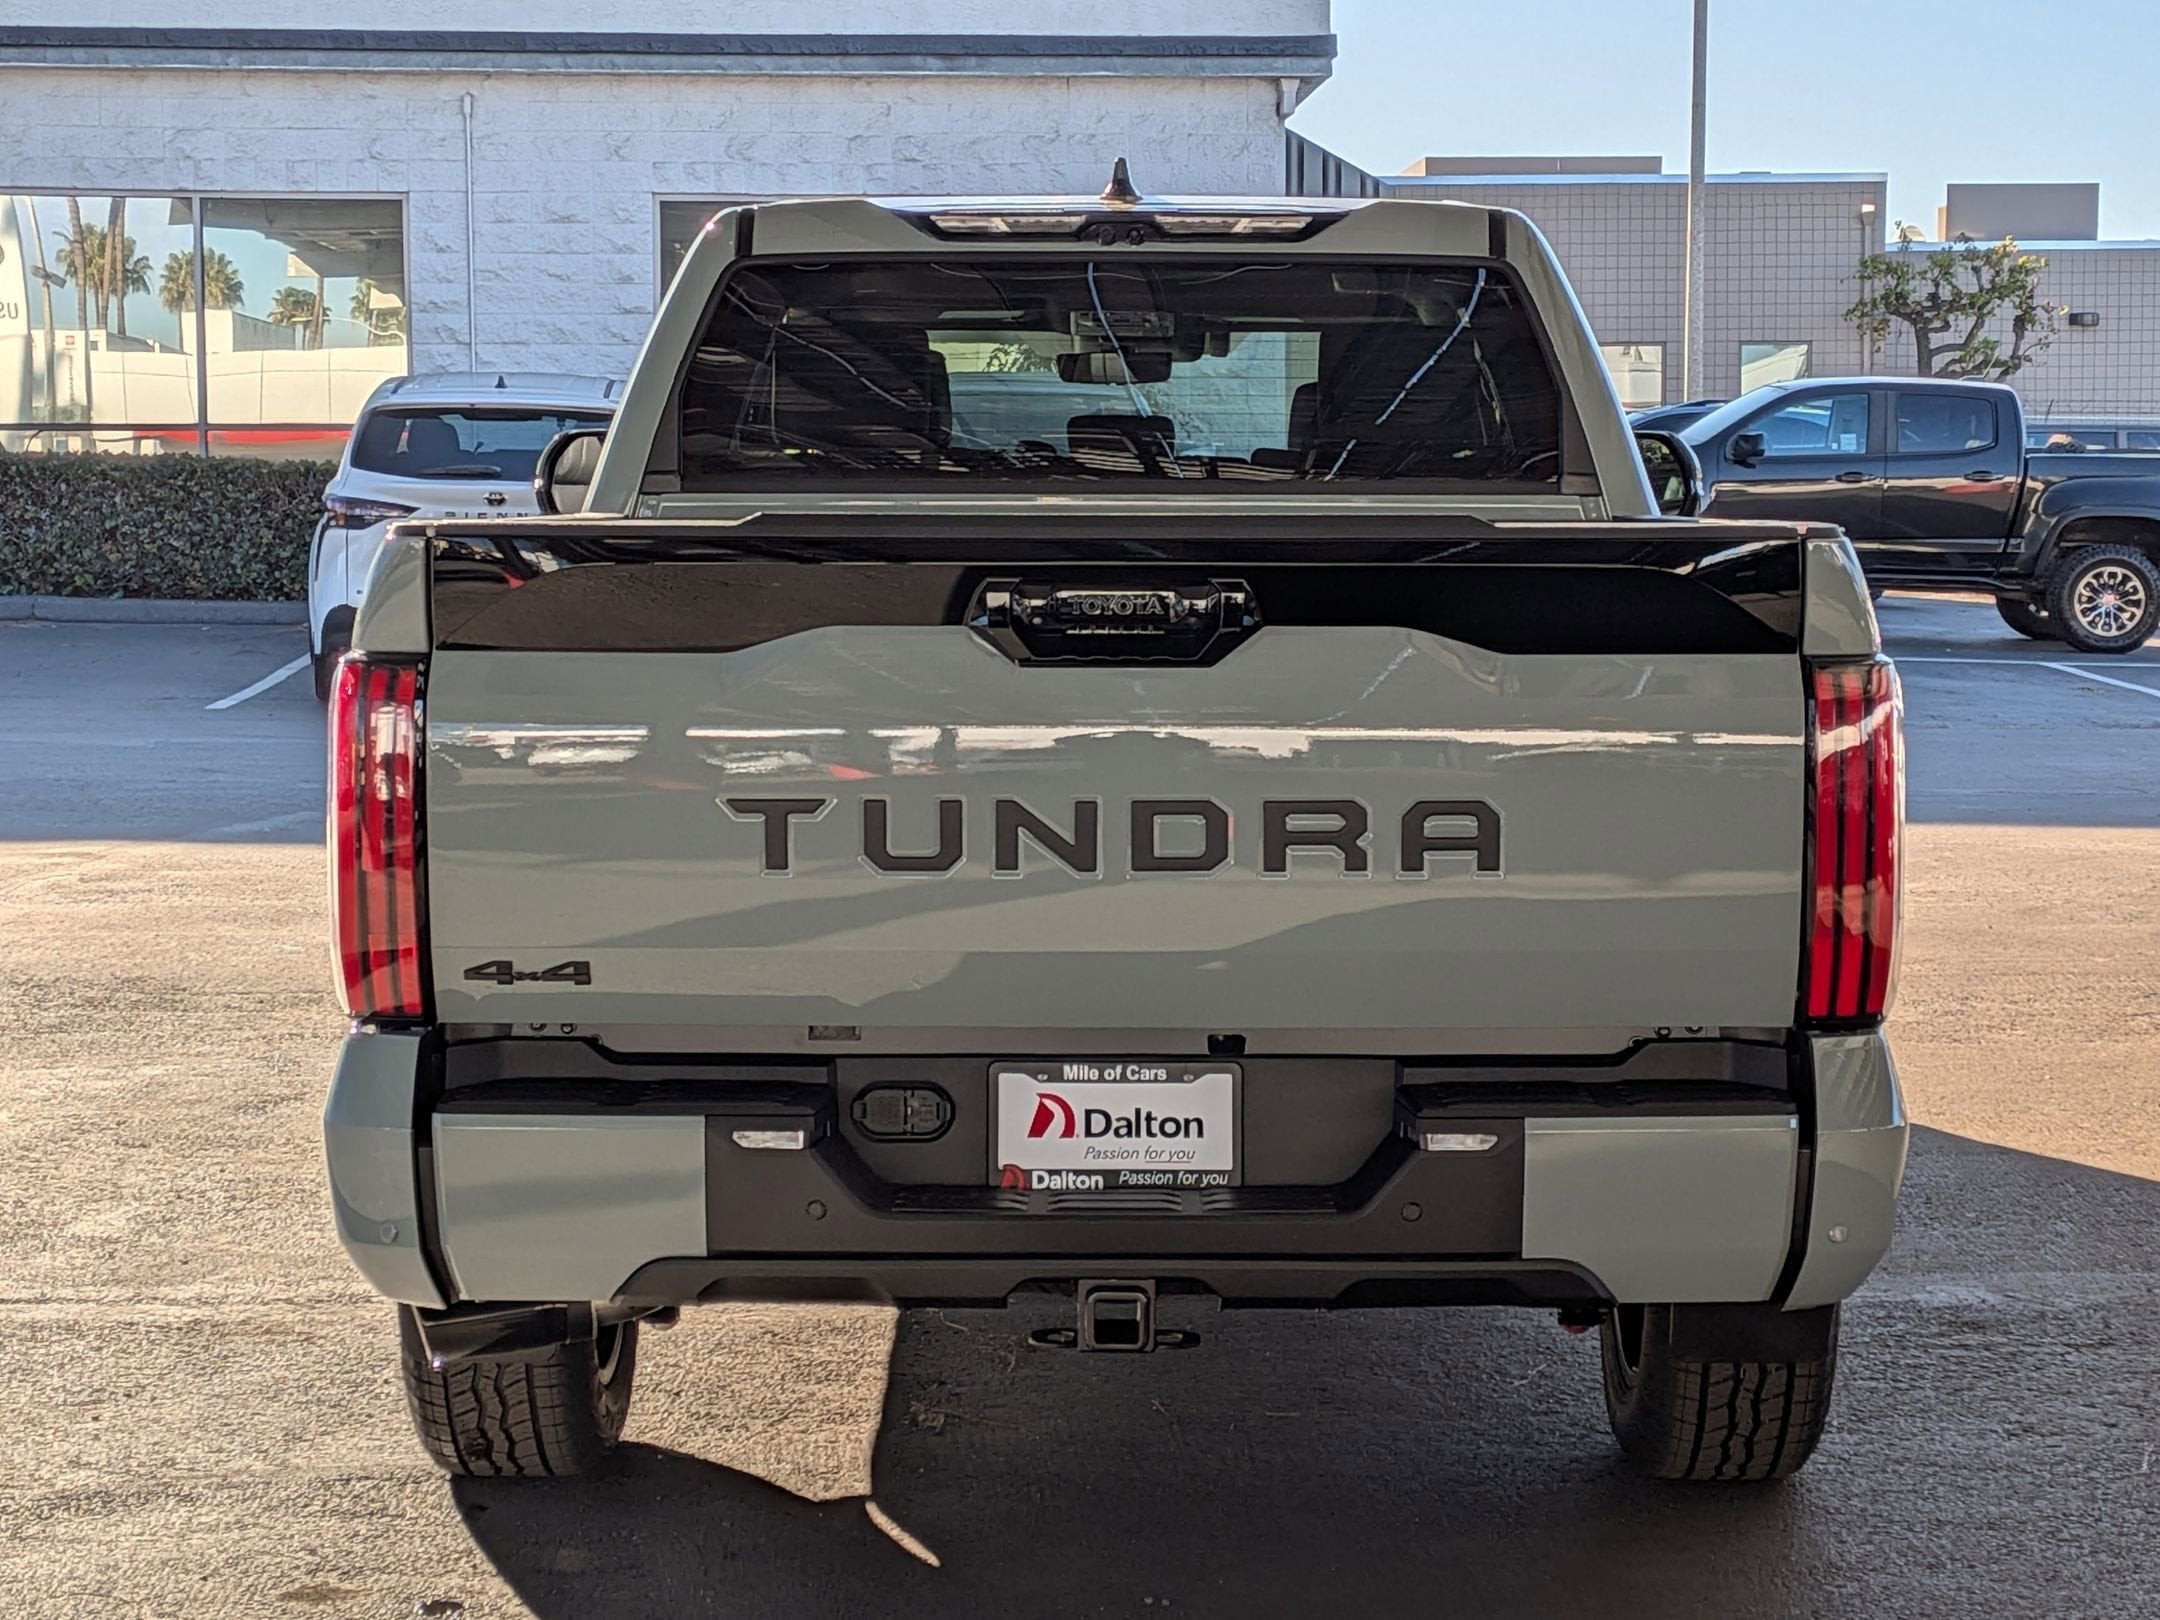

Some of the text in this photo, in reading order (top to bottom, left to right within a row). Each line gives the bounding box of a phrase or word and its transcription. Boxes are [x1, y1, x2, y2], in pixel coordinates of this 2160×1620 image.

[1068, 594, 1165, 615] TOYOTA
[716, 796, 1504, 879] TUNDRA
[1063, 1064, 1168, 1081] Mile of Cars
[1084, 1107, 1204, 1139] Dalton
[1084, 1146, 1195, 1162] Passion for you
[1032, 1170, 1104, 1190] Dalton
[1118, 1170, 1229, 1187] Passion for you
